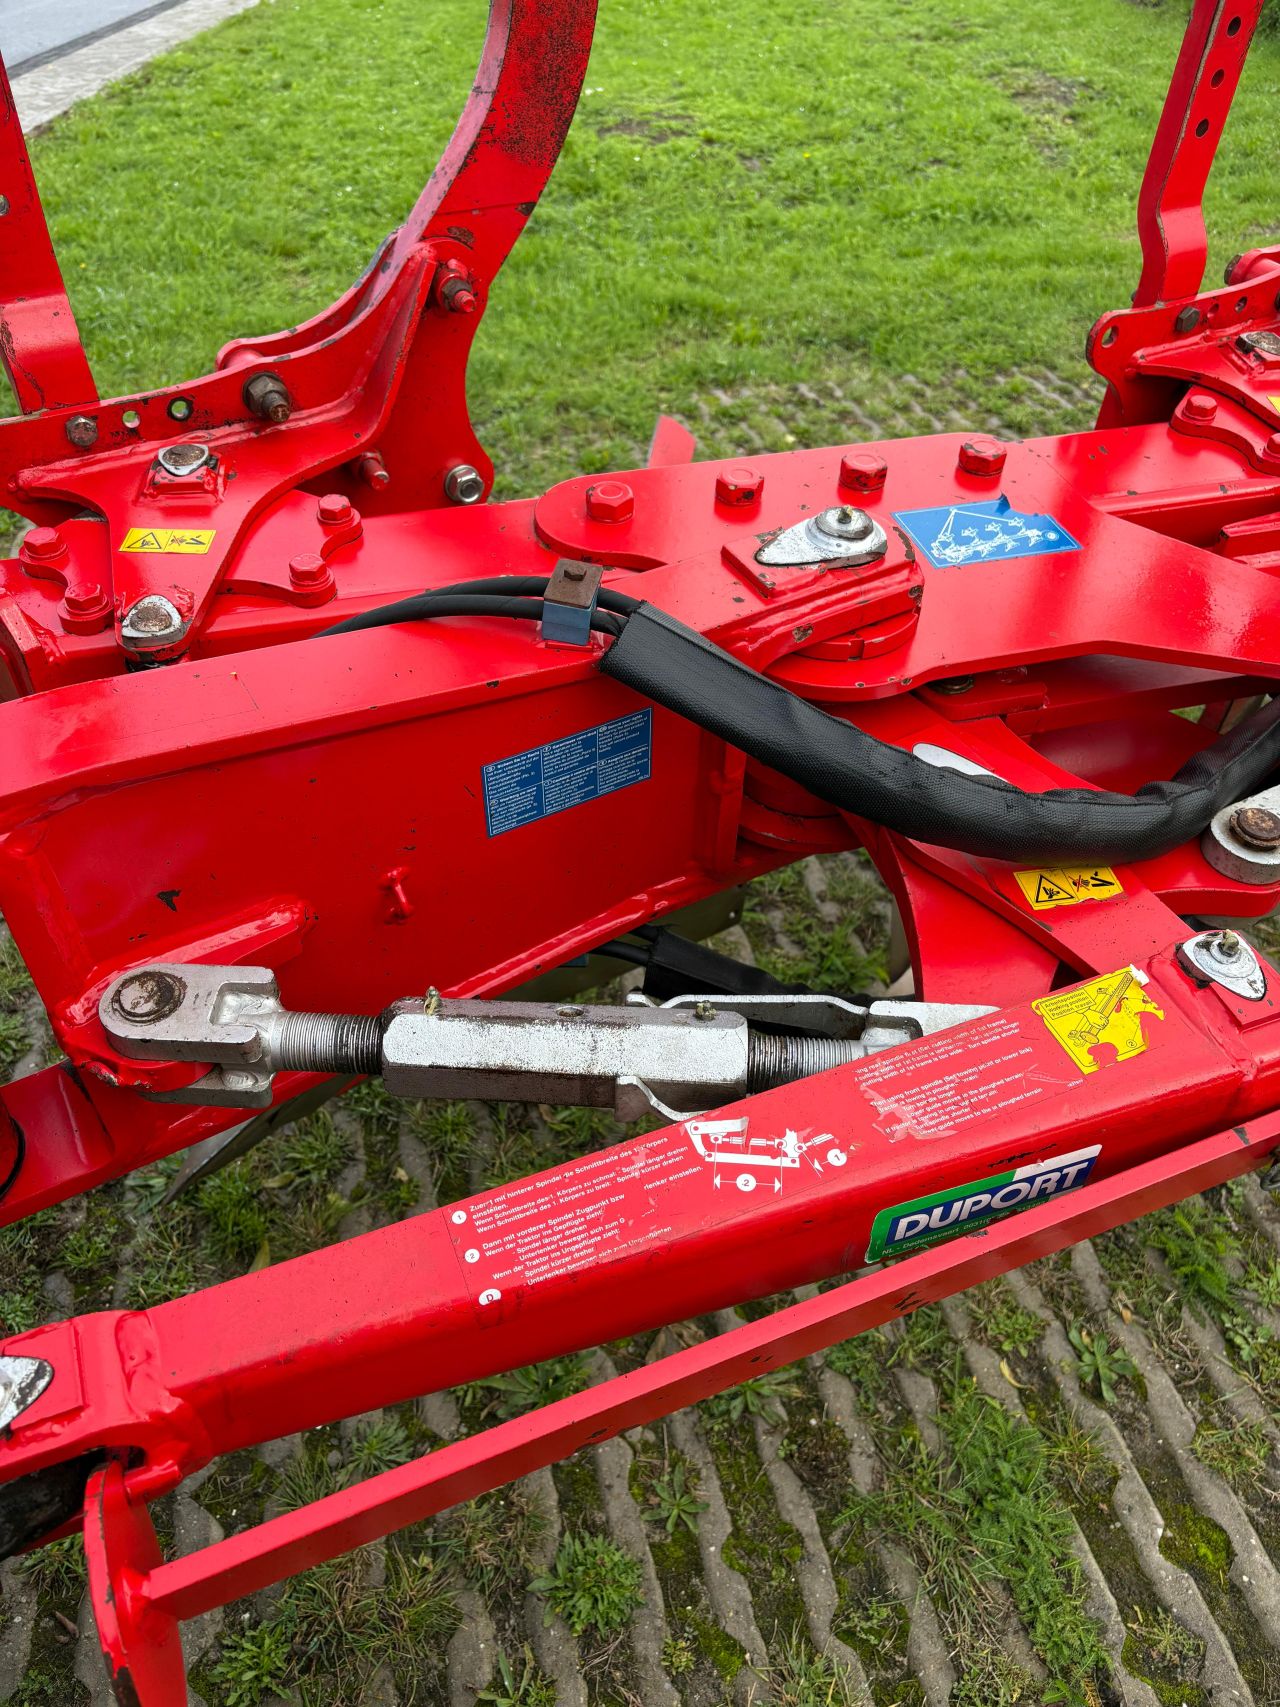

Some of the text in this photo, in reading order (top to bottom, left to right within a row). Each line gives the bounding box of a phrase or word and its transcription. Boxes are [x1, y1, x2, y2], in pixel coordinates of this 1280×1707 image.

[978, 1079, 1004, 1092] ploughed
[474, 1216, 493, 1226] Wenn
[494, 1201, 535, 1219] Schnittbreite
[556, 1184, 582, 1196] Körpers
[666, 1146, 688, 1156] drehen
[476, 1223, 495, 1232] Wenn
[496, 1208, 537, 1226] Schnittbreite
[559, 1191, 585, 1203] Körpers
[640, 1163, 660, 1173] kürzer
[662, 1155, 683, 1166] drehen
[494, 1194, 505, 1202] mit
[506, 1185, 533, 1198] hinterer
[535, 1174, 561, 1187] Spindel
[574, 1155, 618, 1173] Schnittbreite
[472, 1203, 508, 1219] einstellen.
[482, 1239, 501, 1249] Dann
[503, 1233, 515, 1241] mit
[516, 1223, 545, 1236] vorderer
[547, 1211, 574, 1225] Spindel
[575, 1199, 609, 1215] Zugpunkt
[668, 1166, 702, 1180] einstellen.
[894, 1162, 1088, 1241] DUPORT
[484, 1247, 504, 1256] Wenn
[516, 1233, 540, 1244] Traktor
[553, 1217, 584, 1231] Gepflügte
[586, 1208, 602, 1219] zieht:
[492, 1269, 511, 1279] Wenn
[525, 1255, 548, 1267] Traktor
[561, 1236, 601, 1253] Ungepflügte
[602, 1228, 619, 1238] zieht:
[516, 1224, 586, 1253] Spindel länger drehen
[519, 1221, 618, 1260] Unterlenker bewegen sich zum
[524, 1263, 549, 1277] Spindel
[550, 1255, 571, 1267] kürzer
[527, 1267, 566, 1284] Unterlenker
[487, 1293, 494, 1302] D
